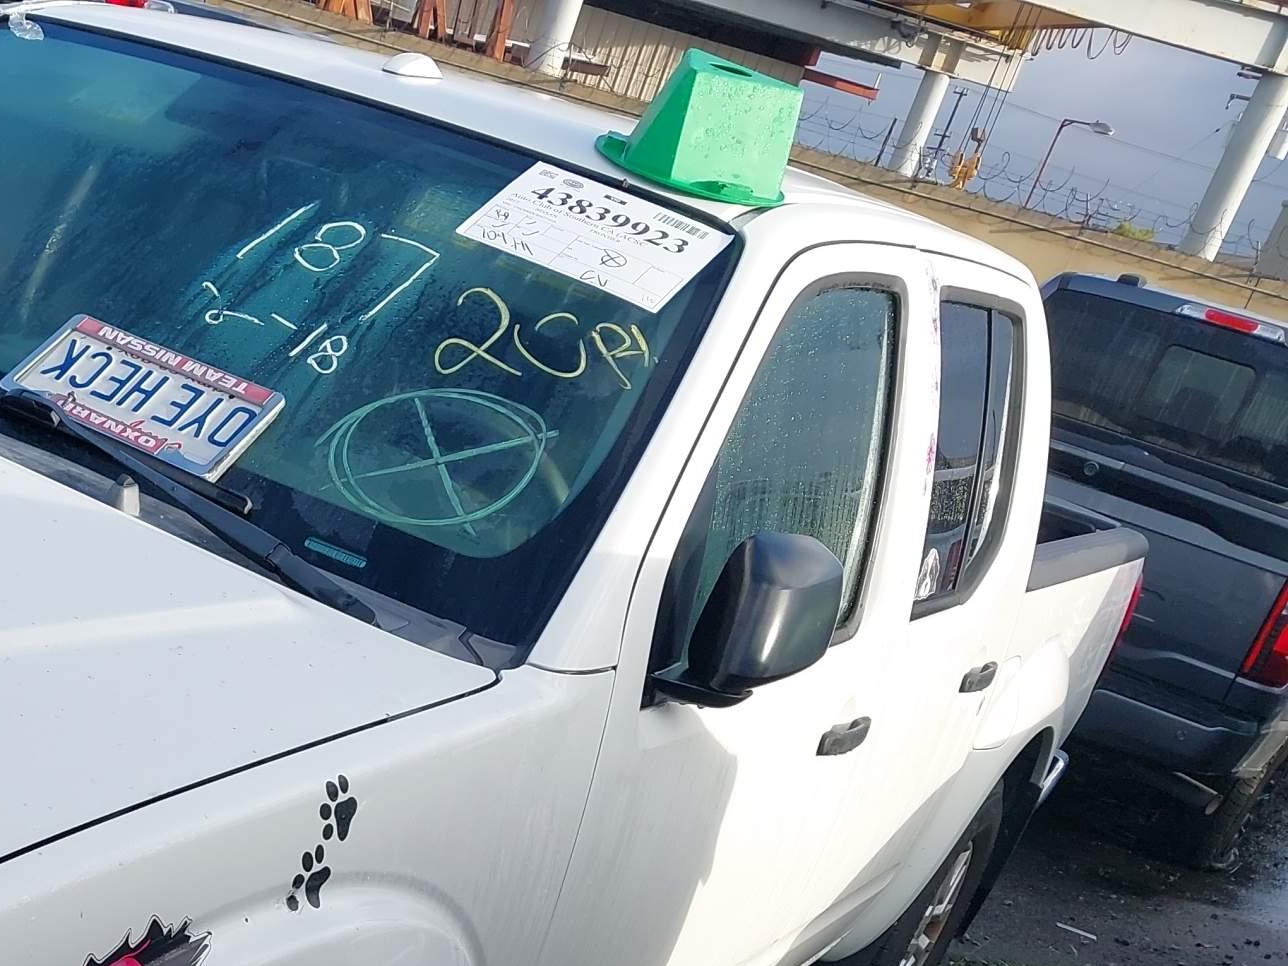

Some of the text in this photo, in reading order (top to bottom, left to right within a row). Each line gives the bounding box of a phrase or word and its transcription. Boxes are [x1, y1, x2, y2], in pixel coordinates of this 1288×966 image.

[531, 187, 689, 254] 43839923
[98, 325, 248, 393] TEAM NISSAN
